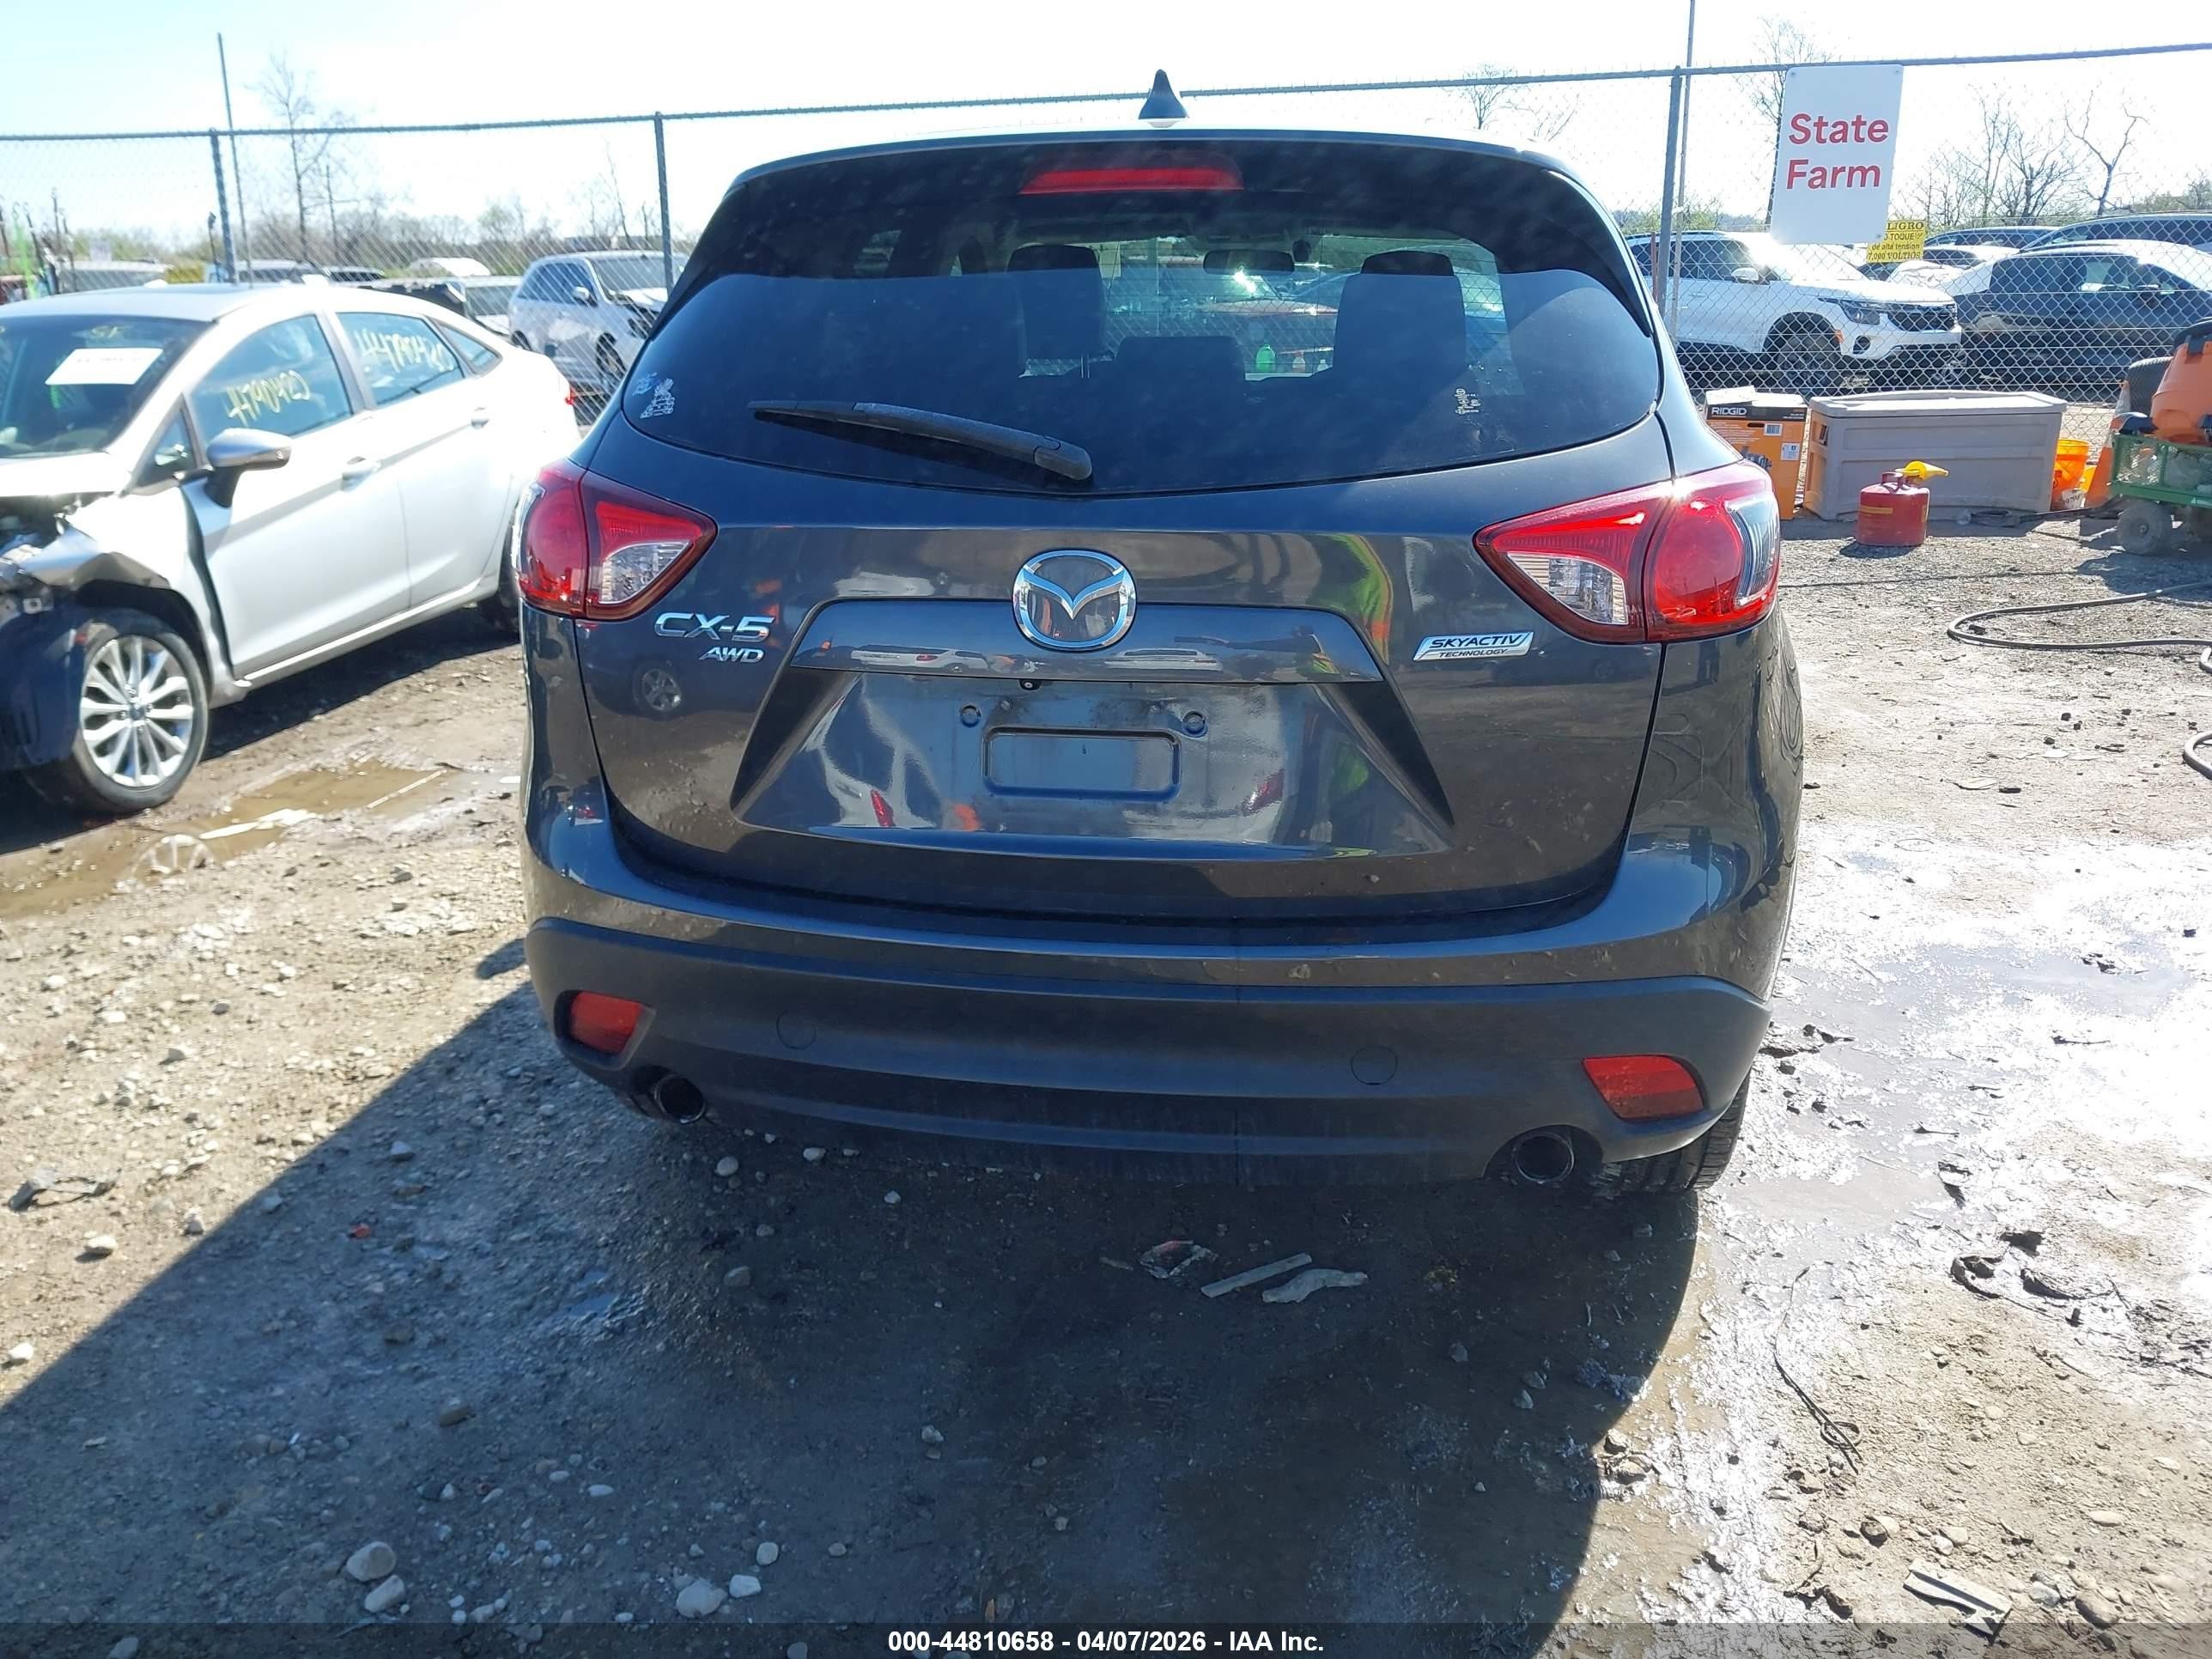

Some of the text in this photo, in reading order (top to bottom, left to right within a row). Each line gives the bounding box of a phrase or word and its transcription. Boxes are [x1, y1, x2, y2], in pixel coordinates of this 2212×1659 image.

[1789, 112, 1889, 145] State
[1786, 158, 1881, 190] Farm
[1887, 222, 1923, 230] LIGRO
[1711, 407, 1747, 416] RIDGID
[654, 612, 775, 642] CX-5
[1429, 635, 1522, 648] SKYACTIV
[699, 647, 764, 663] AWD
[1439, 648, 1507, 658] TECHNOLOGY
